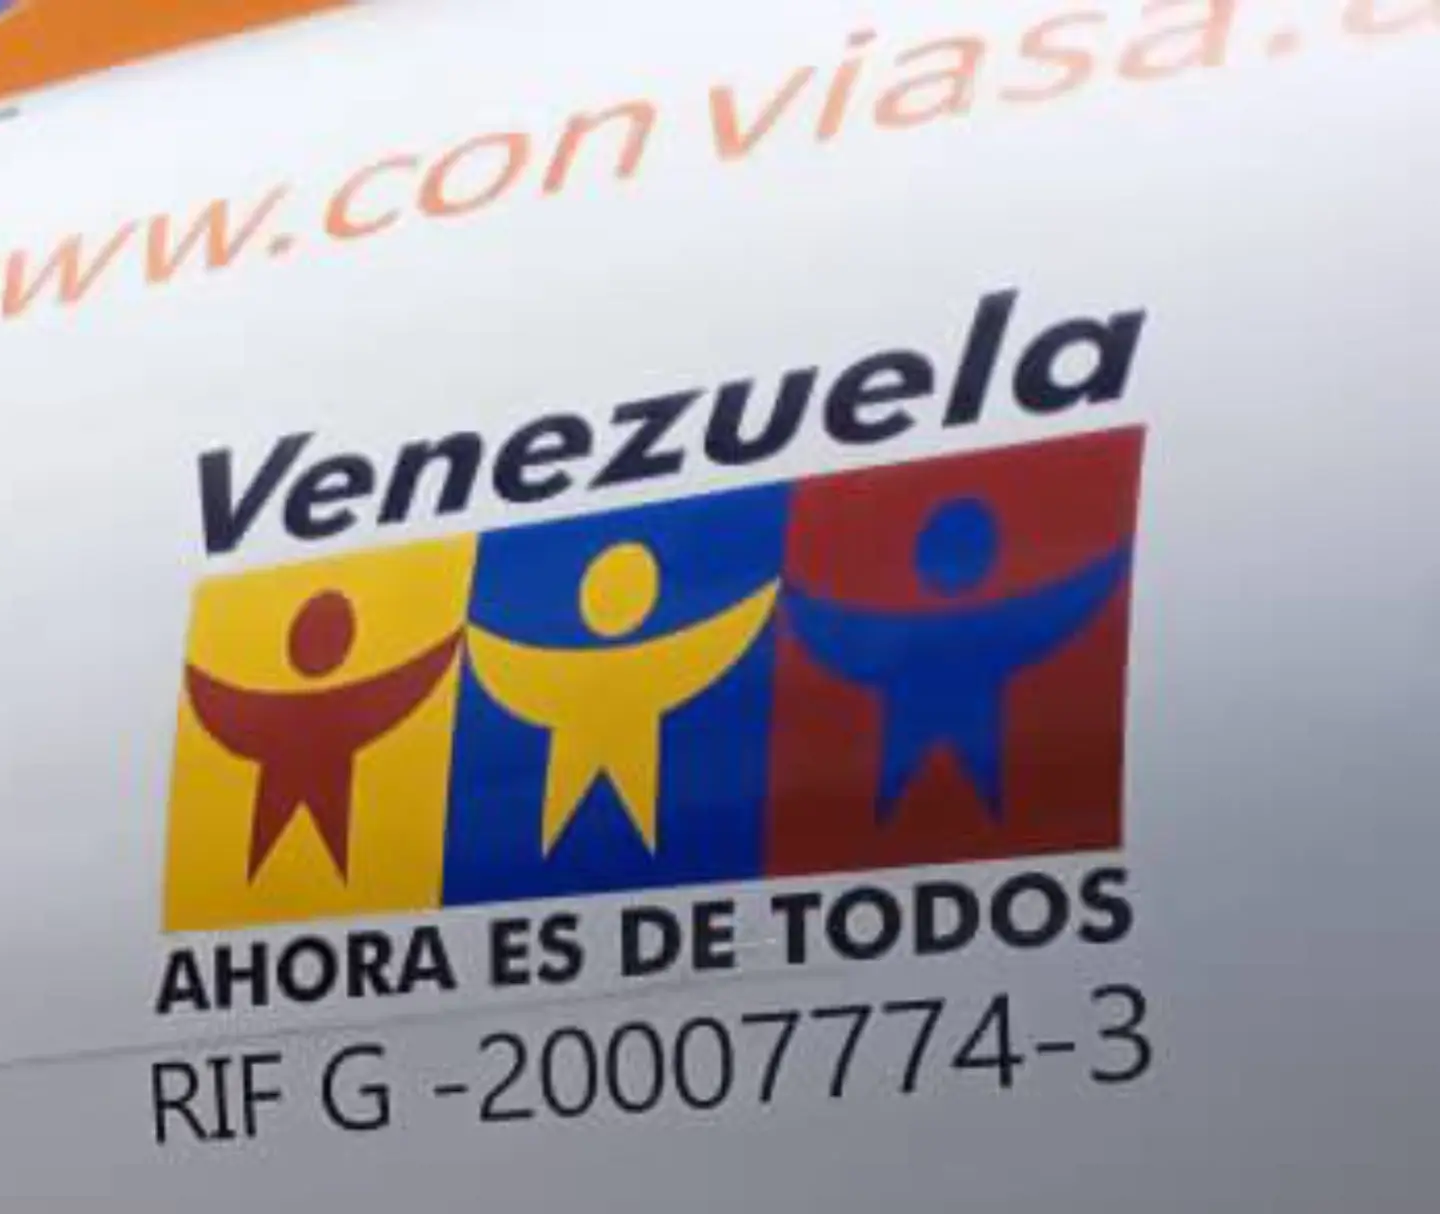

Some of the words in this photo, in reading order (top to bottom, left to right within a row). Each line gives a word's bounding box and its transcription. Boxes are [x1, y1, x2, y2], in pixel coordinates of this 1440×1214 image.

[195, 289, 1146, 556] Venezuela
[155, 925, 457, 1014] AHORA
[487, 913, 585, 987] ES
[618, 897, 737, 978] DE
[770, 867, 1135, 967] TODOS
[150, 1050, 283, 1145] RIF
[318, 1043, 392, 1132] G
